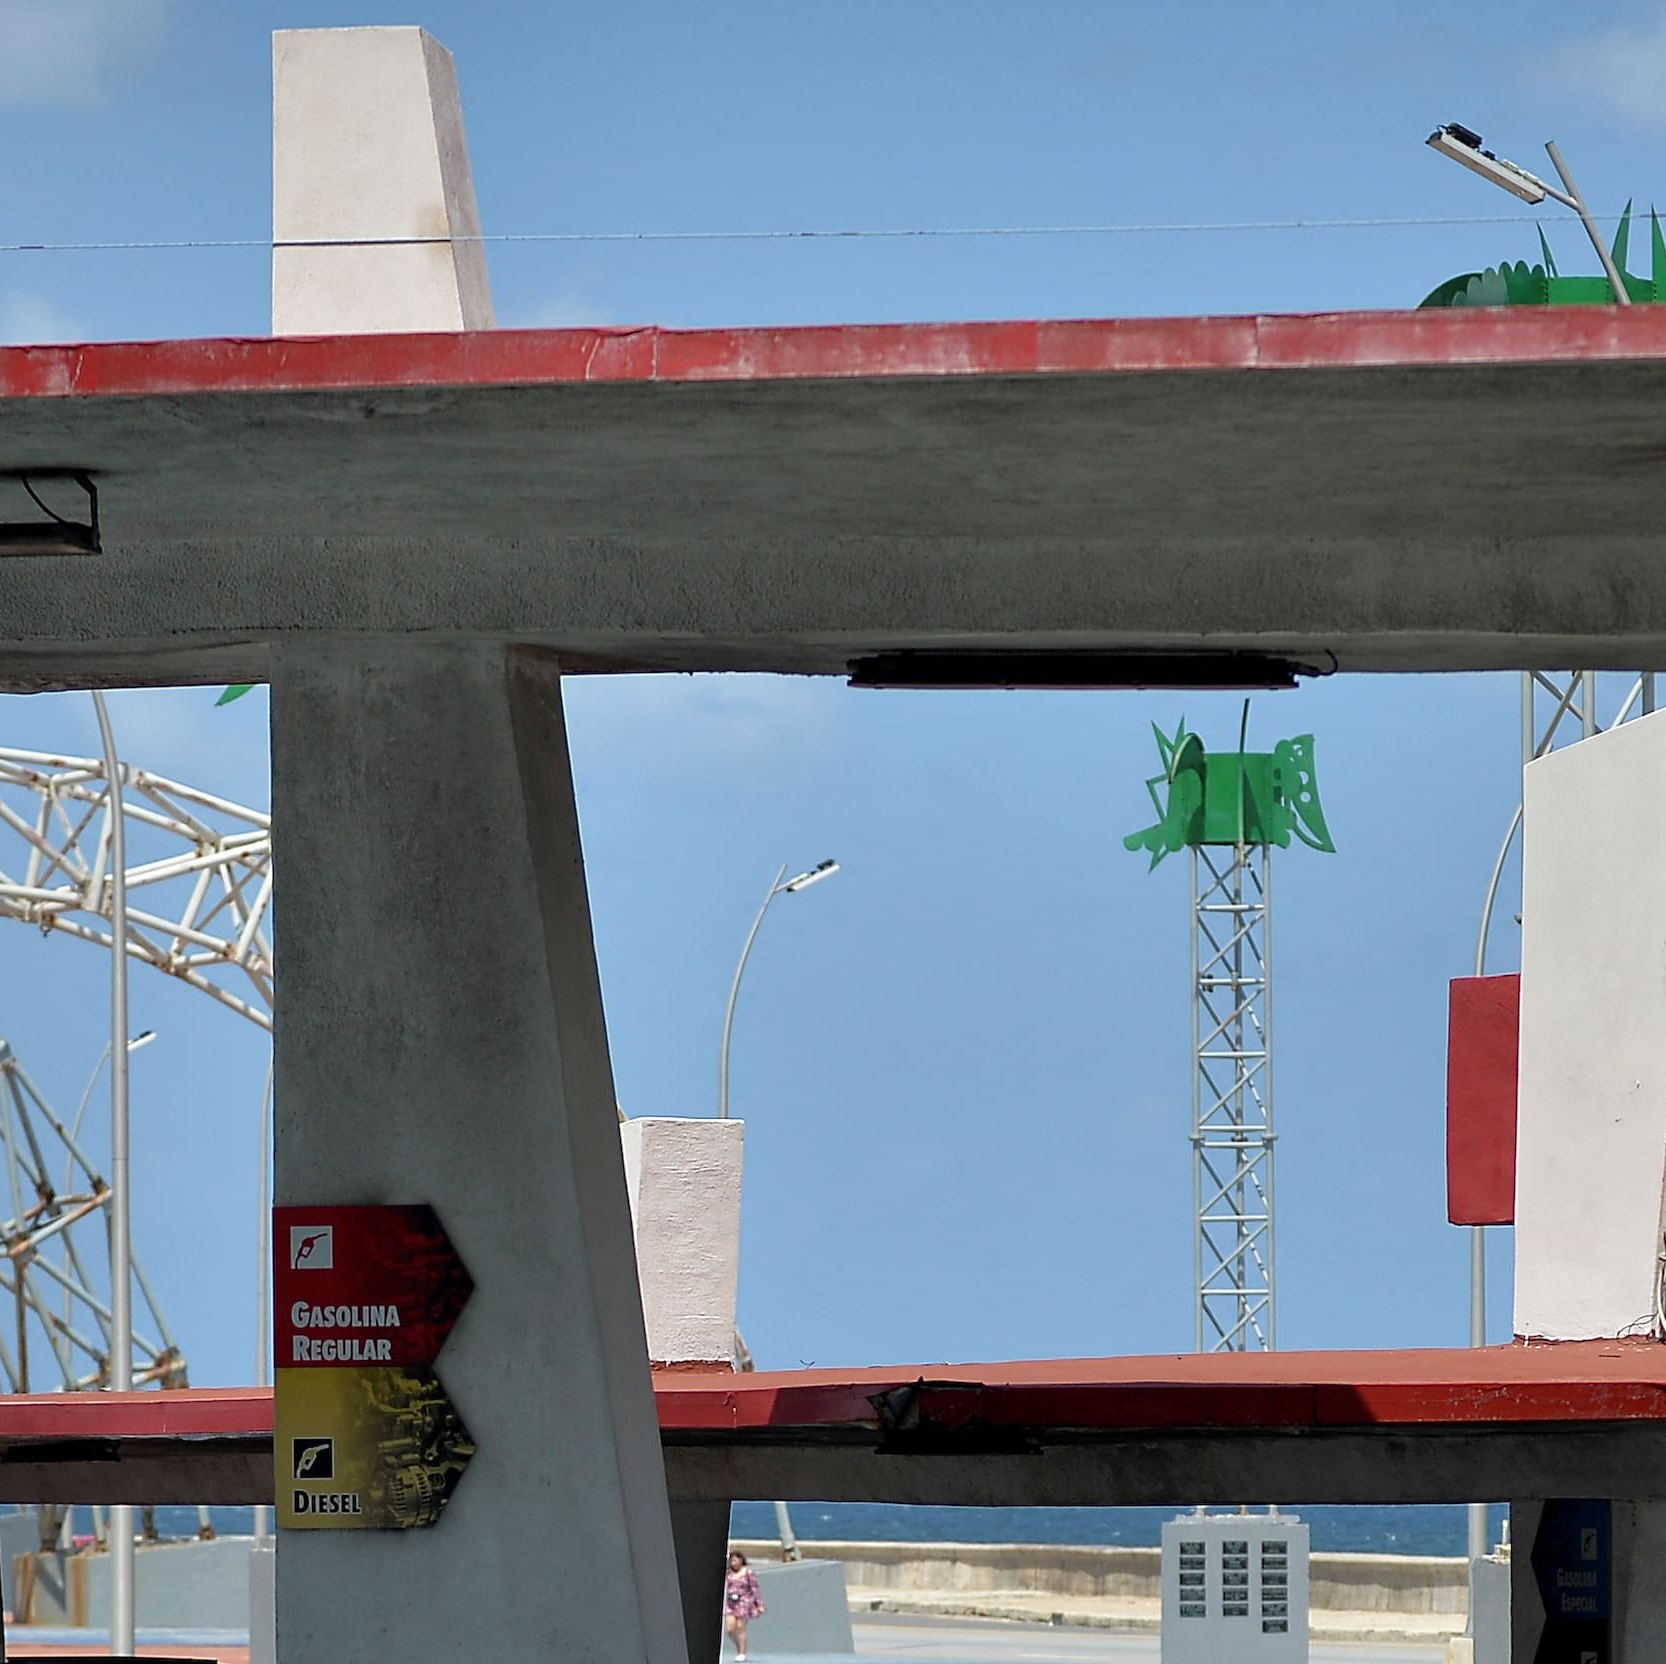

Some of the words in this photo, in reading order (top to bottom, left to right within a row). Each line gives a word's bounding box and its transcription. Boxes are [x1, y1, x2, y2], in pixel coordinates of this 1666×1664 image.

[291, 1300, 401, 1329] GASOLINA
[292, 1334, 392, 1361] REGULAR
[293, 1490, 362, 1515] DIESEL
